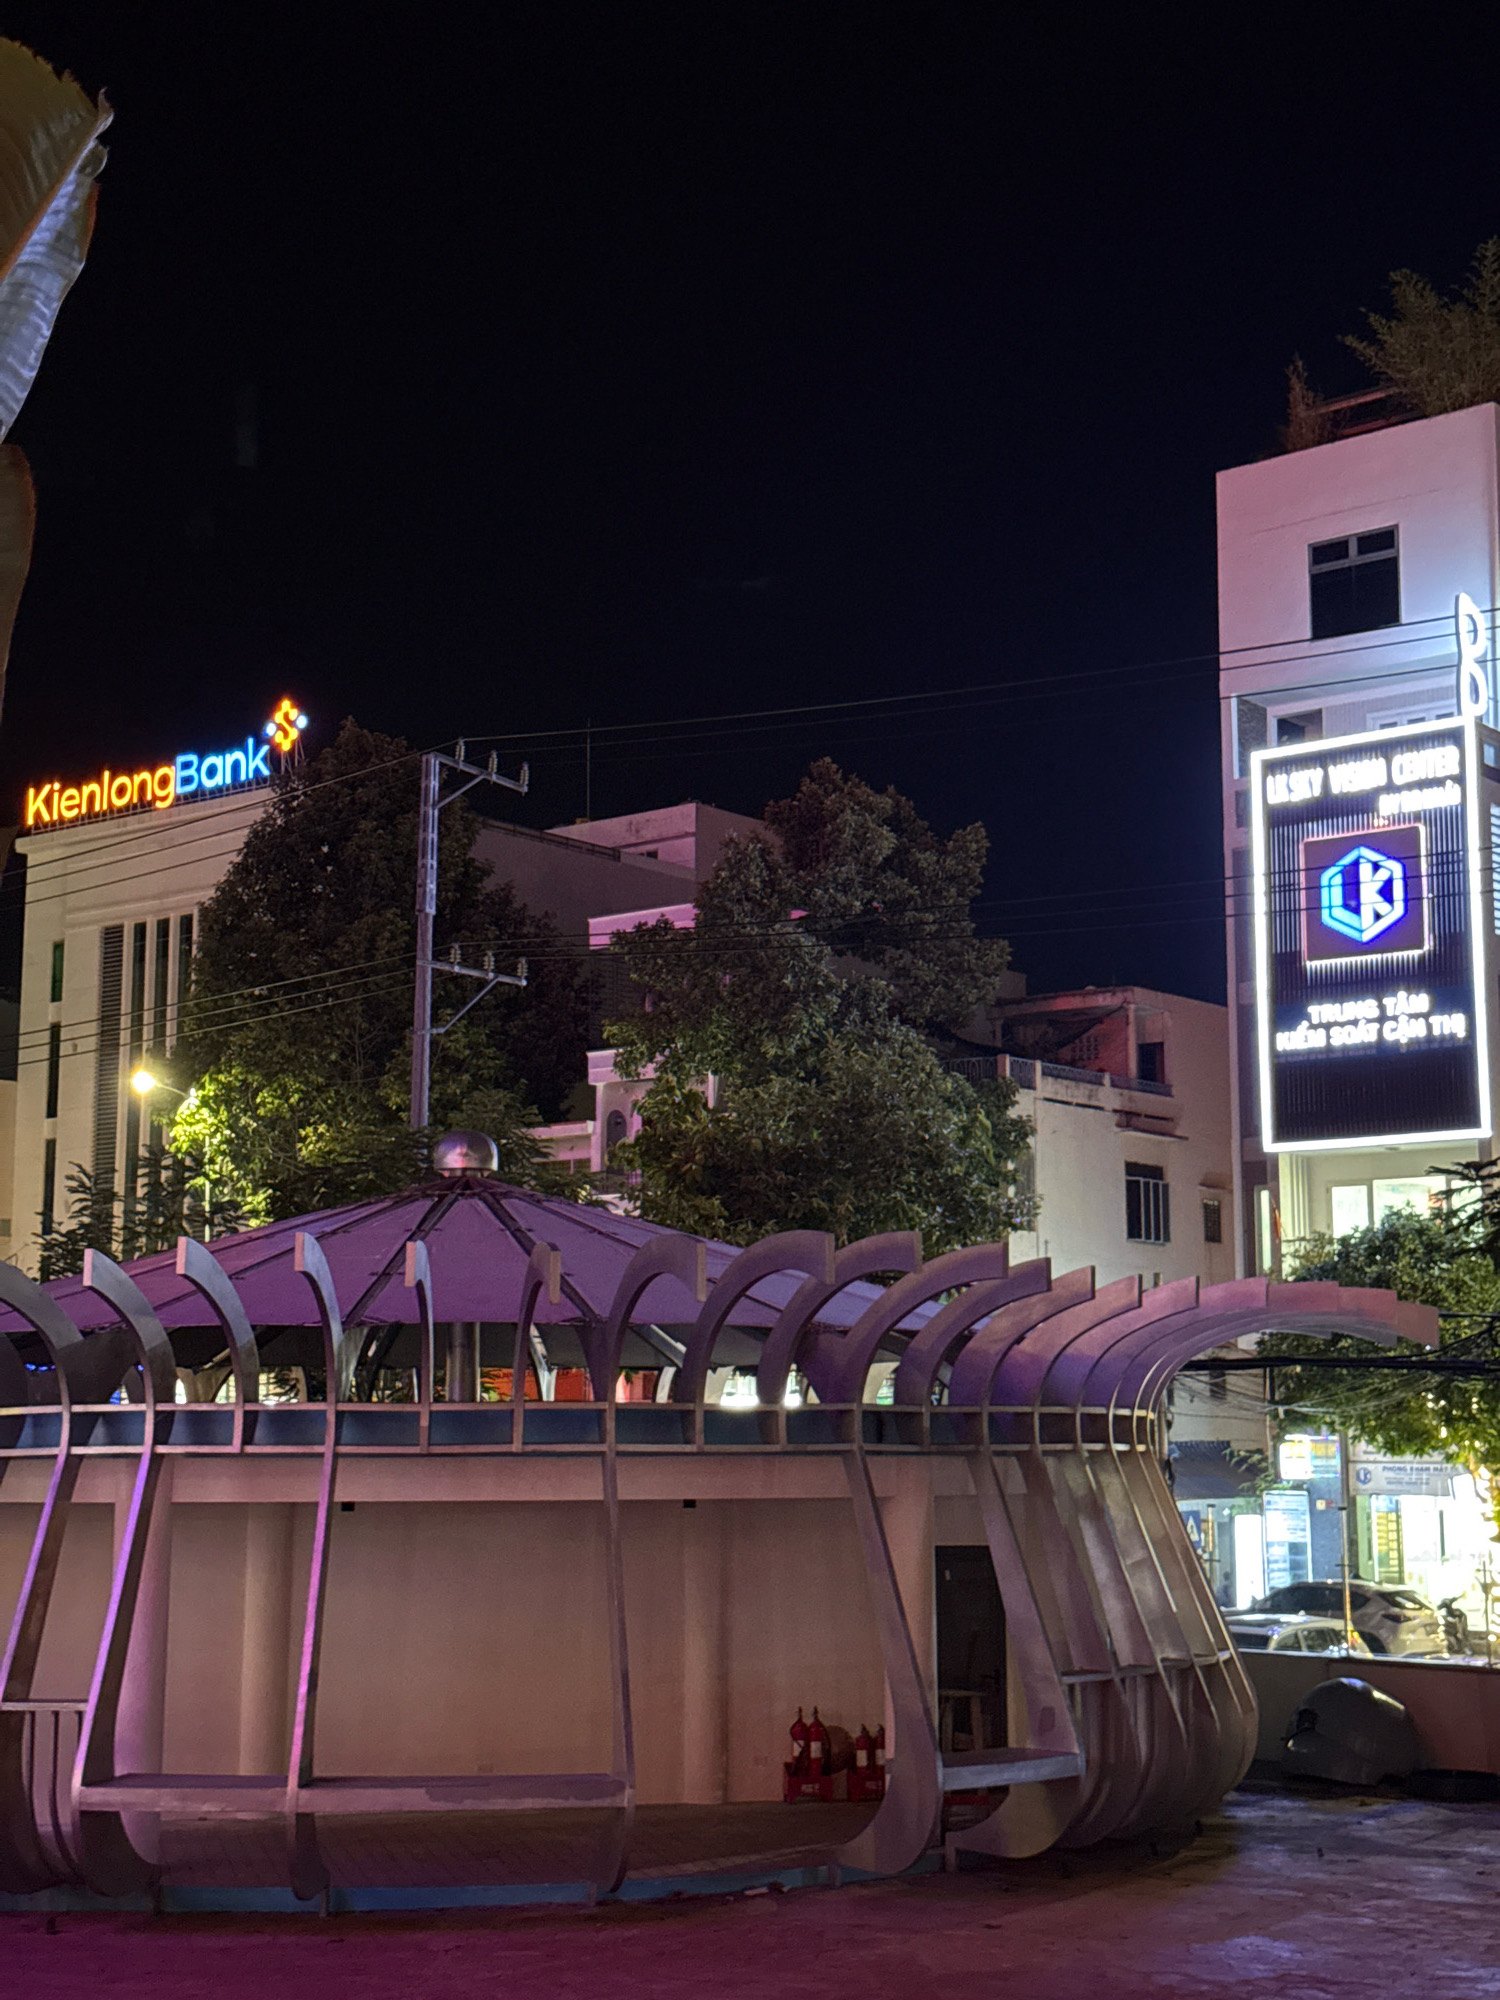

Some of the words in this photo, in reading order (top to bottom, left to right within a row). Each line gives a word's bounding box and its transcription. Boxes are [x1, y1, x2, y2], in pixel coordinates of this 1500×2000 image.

[27, 736, 270, 825] KienlongBank
[1391, 745, 1460, 785] CENTER
[1307, 999, 1379, 1024] TRUNG
[1382, 990, 1430, 1016] TÂM
[1276, 1019, 1326, 1051] KIỂM
[1330, 1018, 1380, 1046] SOÁT
[1383, 1014, 1427, 1043] CẬN
[1429, 1013, 1466, 1038] THỊ
